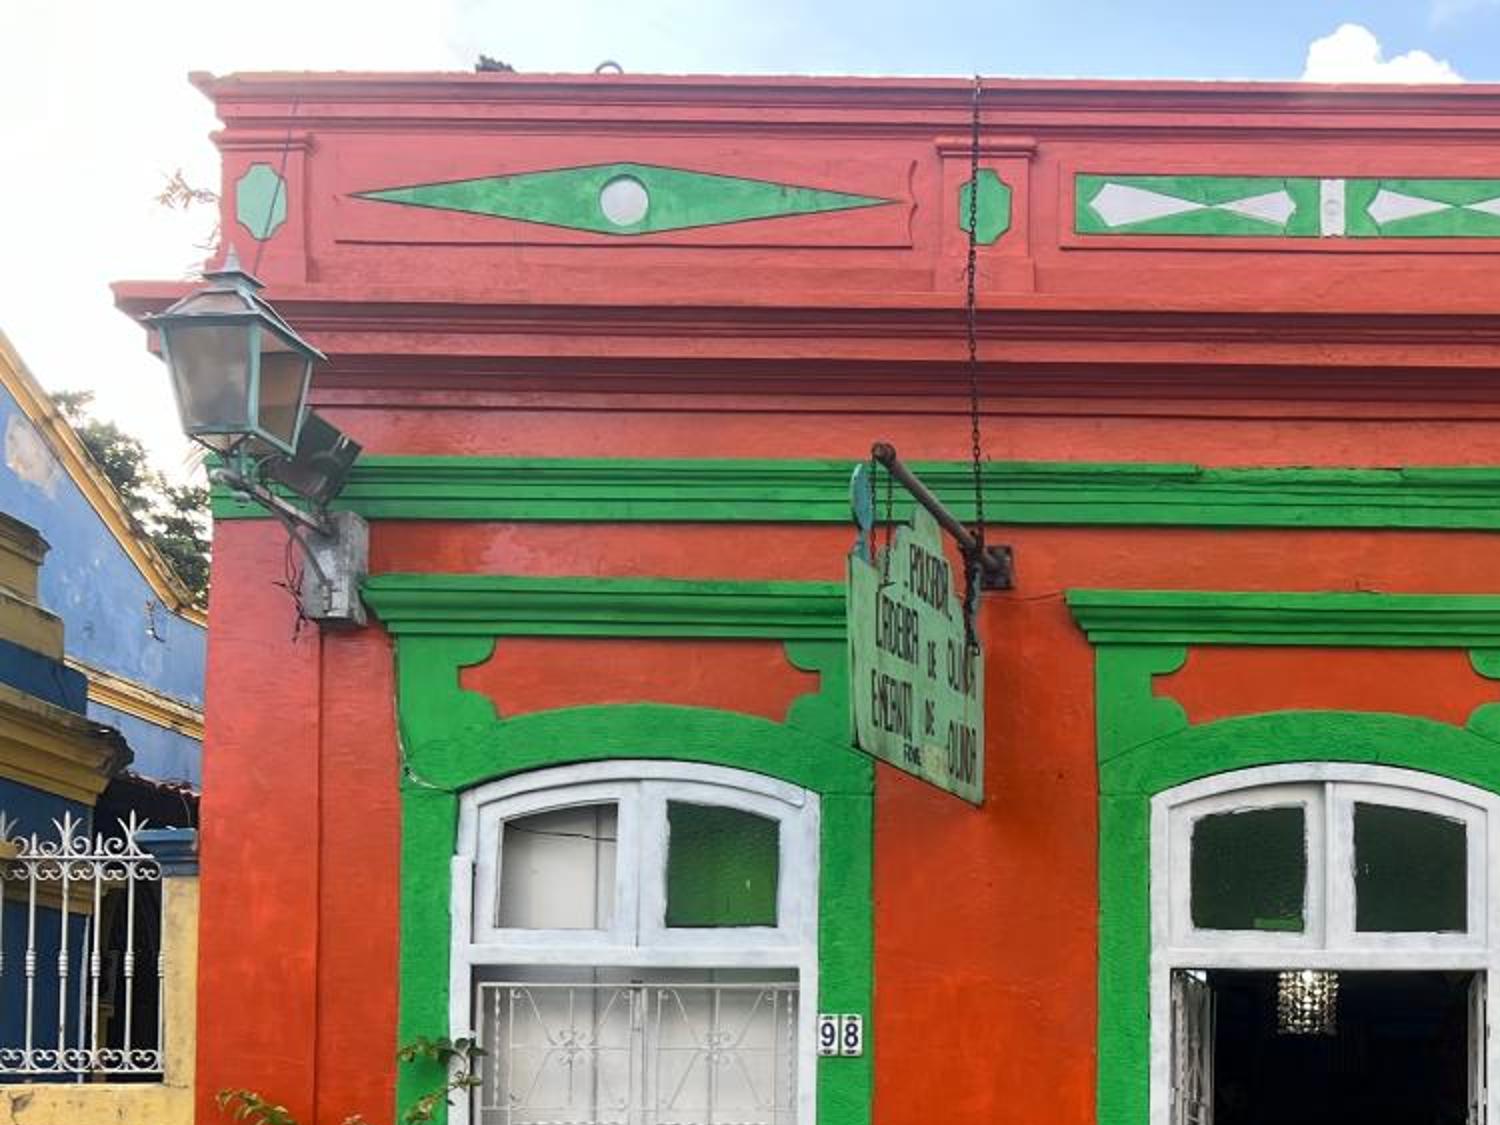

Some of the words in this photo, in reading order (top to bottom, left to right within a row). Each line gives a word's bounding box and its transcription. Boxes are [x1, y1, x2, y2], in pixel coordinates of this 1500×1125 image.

[875, 591, 918, 665] LADEIRA
[927, 640, 936, 680] DE
[870, 668, 912, 741] ENCANTO
[925, 699, 935, 737] DE
[947, 720, 977, 786] OLINDA
[821, 1022, 858, 1048] 98
